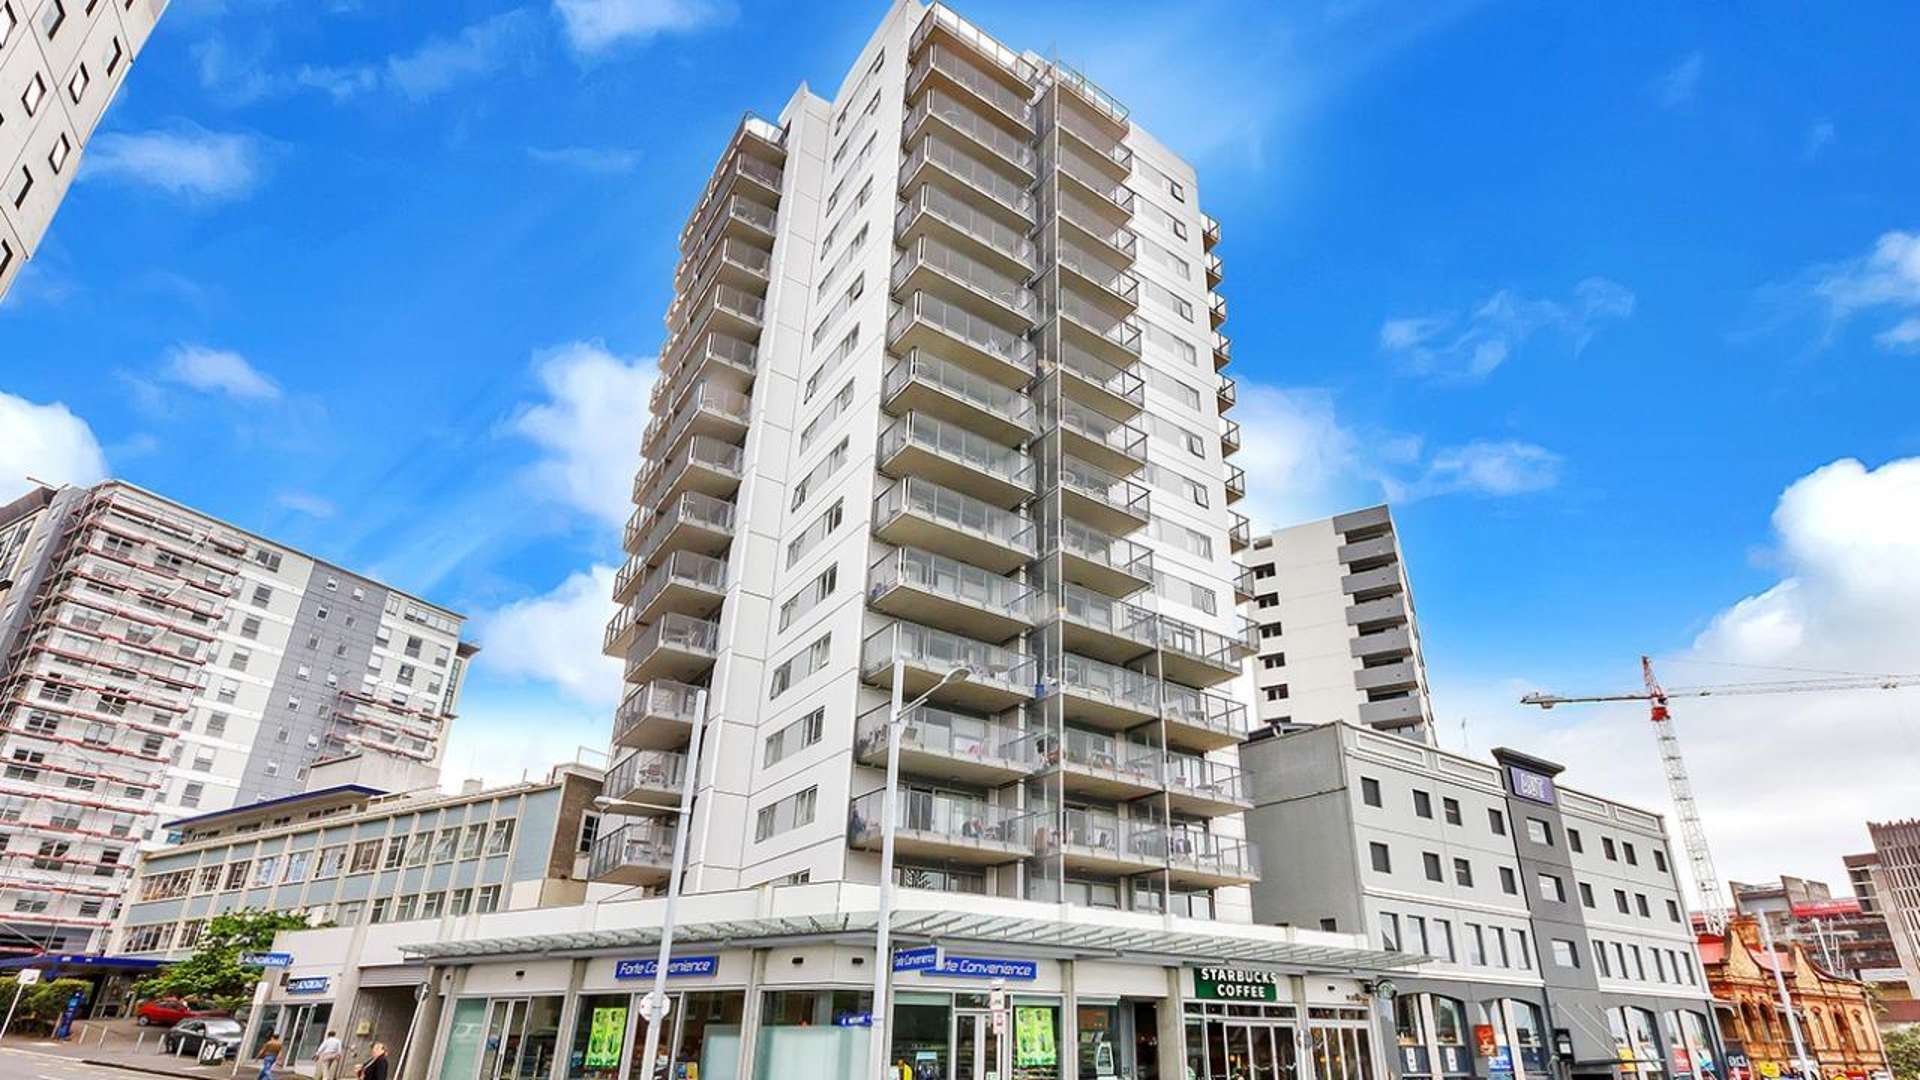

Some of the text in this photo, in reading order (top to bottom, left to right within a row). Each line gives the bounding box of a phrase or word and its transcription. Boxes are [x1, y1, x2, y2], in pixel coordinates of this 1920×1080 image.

[619, 960, 711, 975] Forte Coenience
[959, 959, 1033, 976] Convenience
[1201, 967, 1278, 985] STARBUCKS
[1217, 984, 1266, 998] COFFEE
